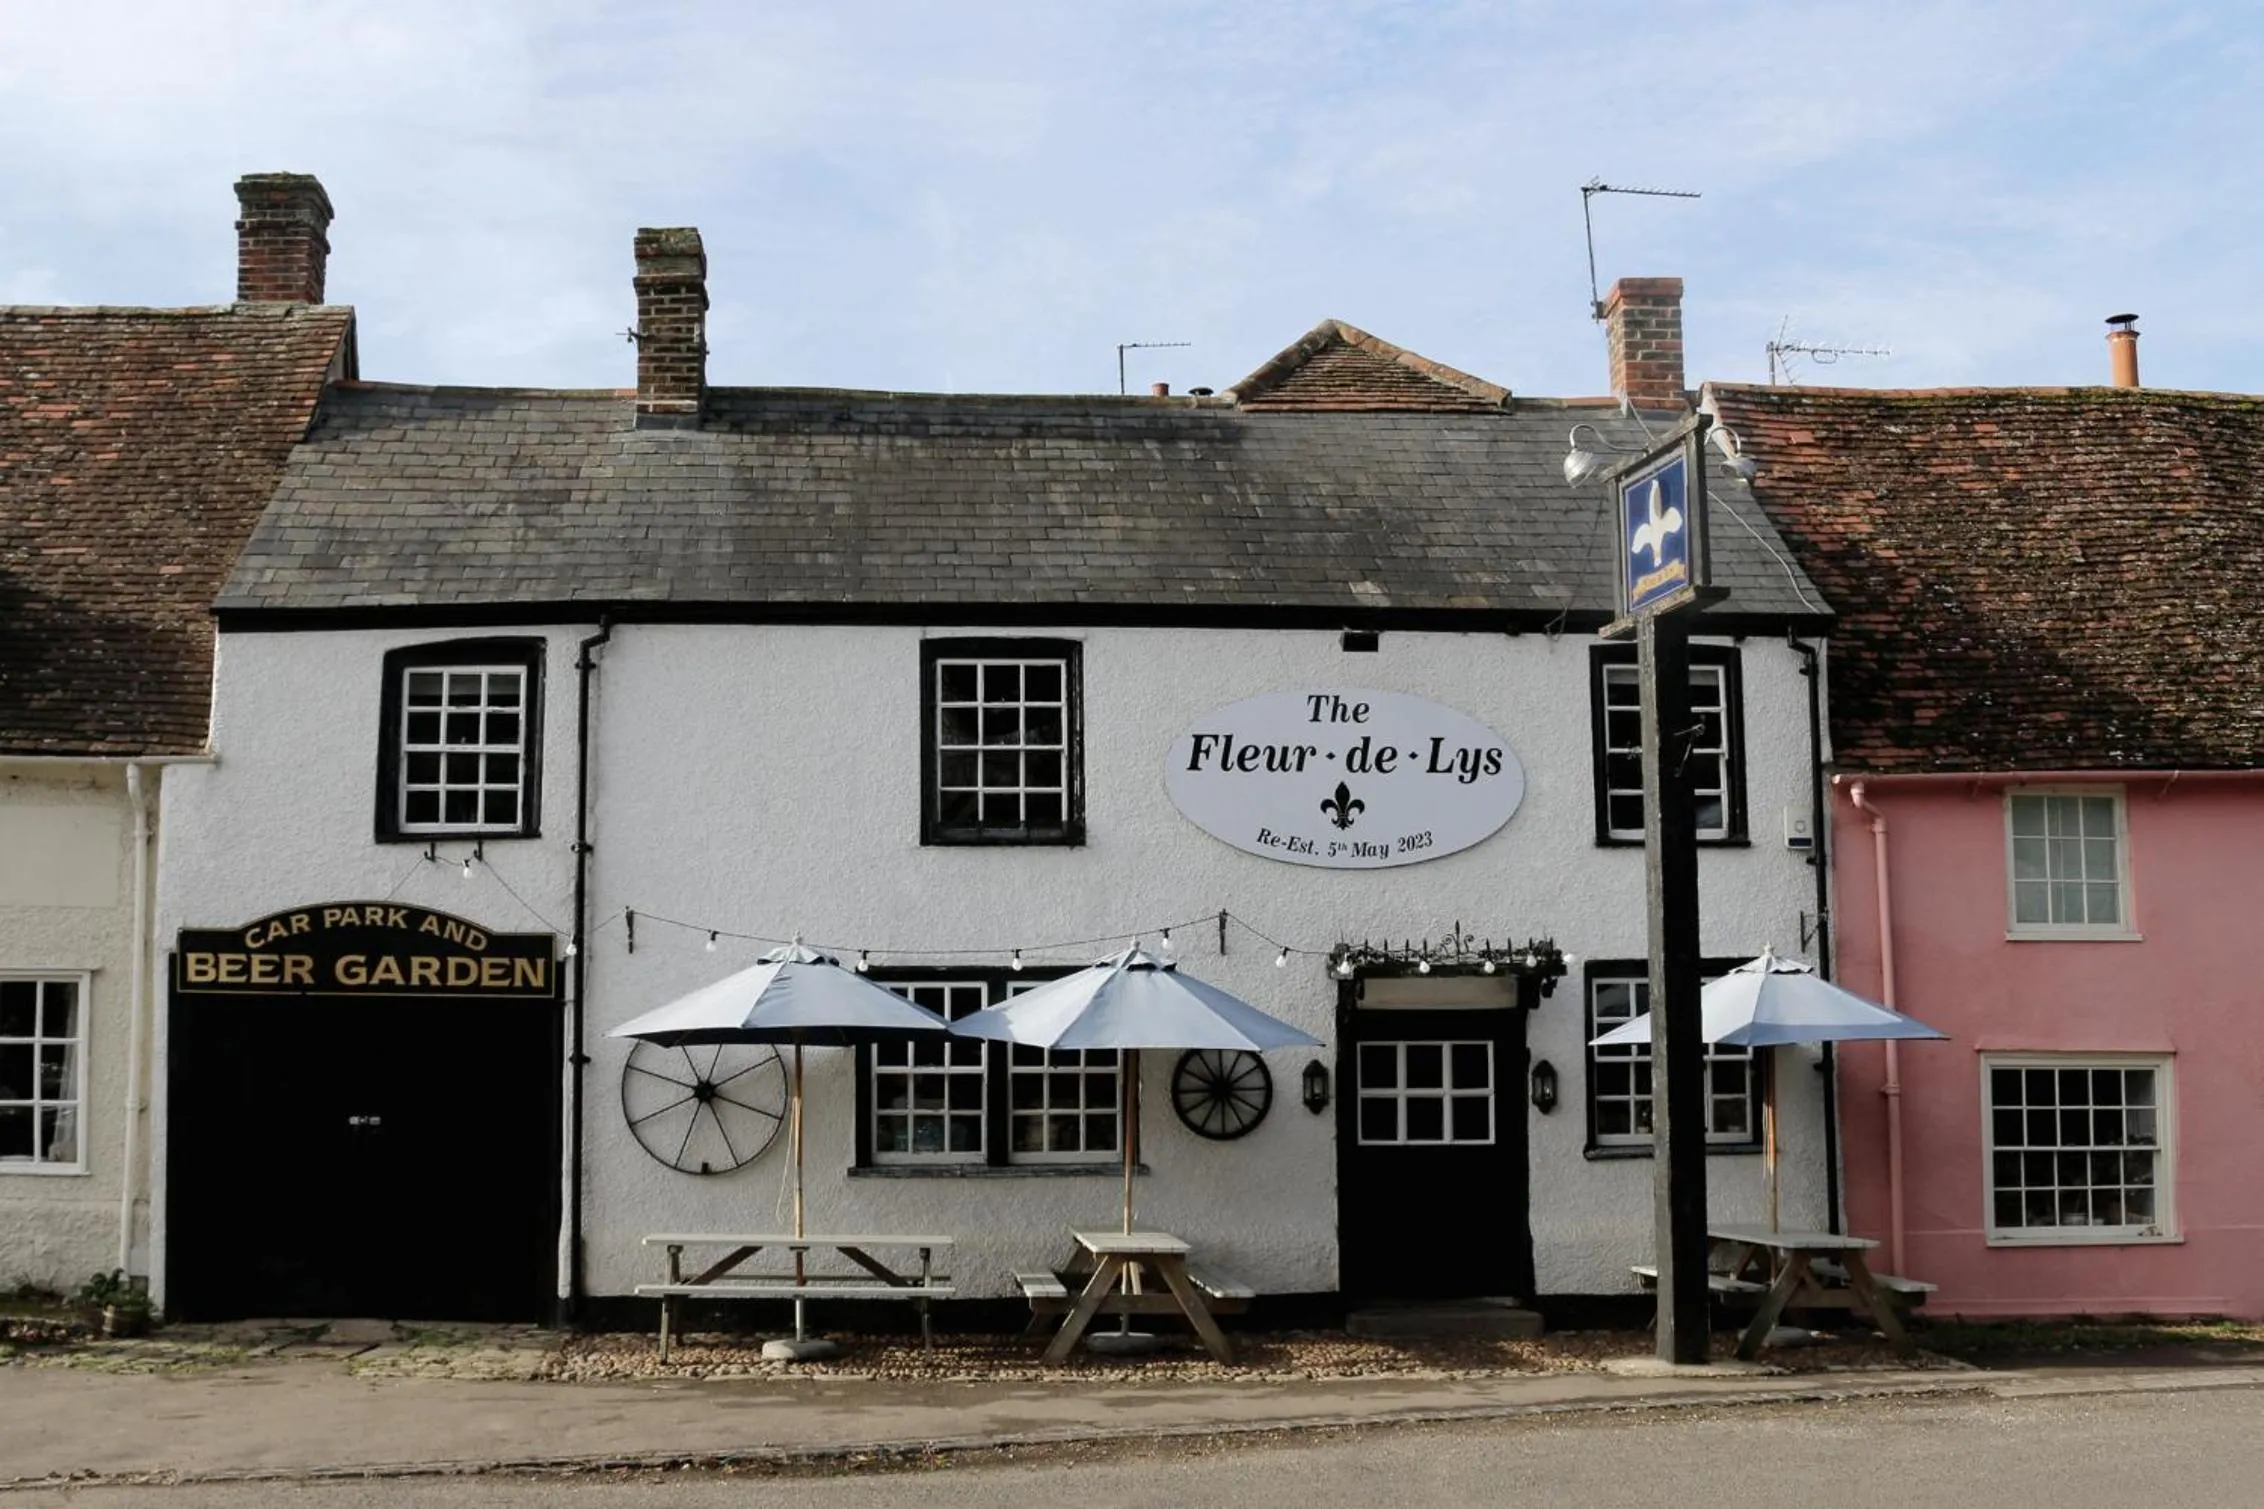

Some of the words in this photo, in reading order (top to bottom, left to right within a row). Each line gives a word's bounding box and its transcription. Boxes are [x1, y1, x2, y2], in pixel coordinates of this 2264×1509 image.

[1307, 695, 1370, 723] The
[1186, 734, 1317, 772] Fleur
[1345, 736, 1398, 773] de
[1426, 737, 1503, 784] Lys
[1256, 828, 1319, 856] Re-Est.
[1328, 842, 1348, 857] 5th
[1351, 842, 1389, 859] May
[1397, 831, 1434, 852] 2023
[244, 914, 311, 949] CAR
[323, 906, 408, 928] PARK
[419, 915, 488, 952] AND
[186, 952, 314, 984] BEER
[334, 954, 545, 987] GARDEN
